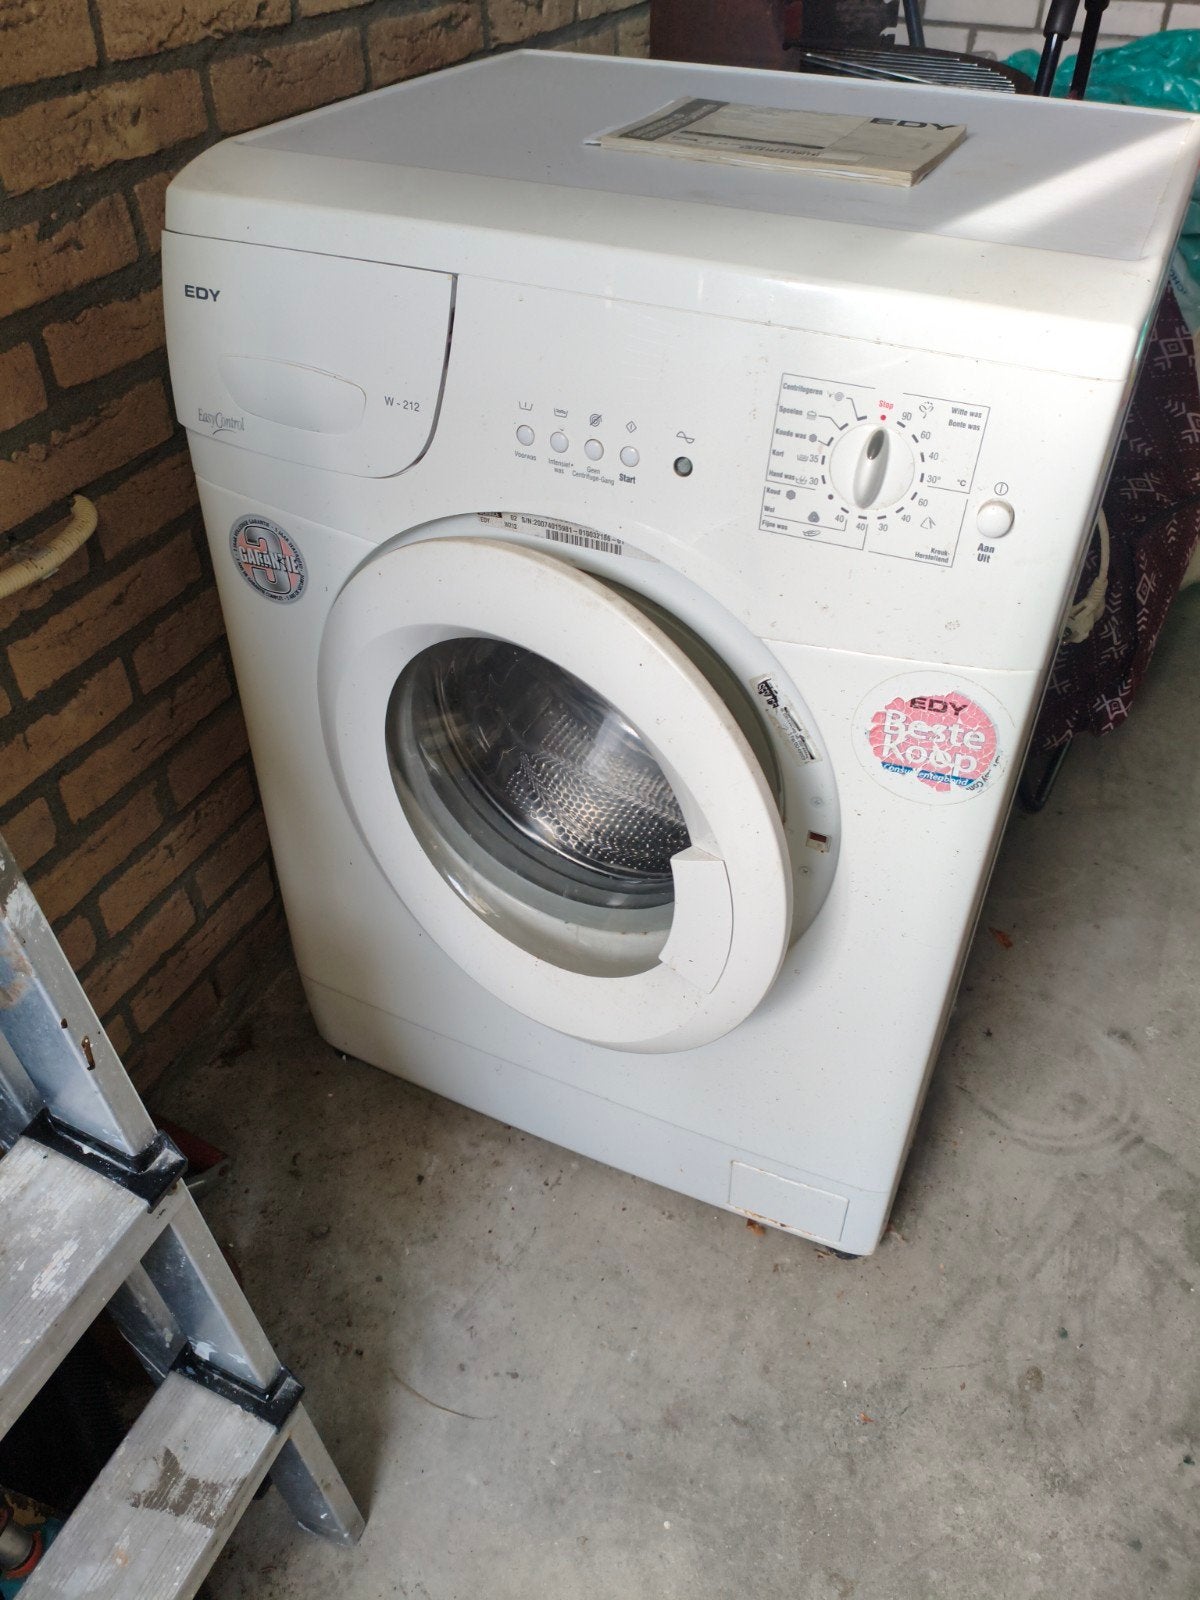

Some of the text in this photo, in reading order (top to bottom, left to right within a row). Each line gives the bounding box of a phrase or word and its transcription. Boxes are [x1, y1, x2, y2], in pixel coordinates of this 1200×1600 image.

[870, 117, 957, 131] EDY
[184, 284, 221, 303] EDY
[878, 400, 894, 410] Stop
[901, 411, 912, 421] 90
[951, 406, 983, 419] Witte was
[948, 418, 981, 431] Bonte was
[920, 430, 931, 440] 60
[771, 449, 784, 458] Kort
[809, 454, 819, 463] 35
[928, 451, 939, 460] 40
[586, 466, 600, 475] Geen
[768, 469, 783, 479] Hand
[618, 473, 636, 485] Start
[809, 477, 818, 486] 30
[766, 487, 781, 496] Koud
[918, 498, 928, 507] 60
[834, 514, 845, 523] 40
[901, 514, 911, 523] 40
[776, 523, 788, 531] was
[856, 522, 866, 531] 40
[878, 523, 888, 532] 30
[977, 542, 995, 554] Aan
[976, 553, 991, 563] Uit
[910, 697, 968, 716] EDY
[884, 709, 986, 750] Beste
[882, 734, 978, 777] Koop
